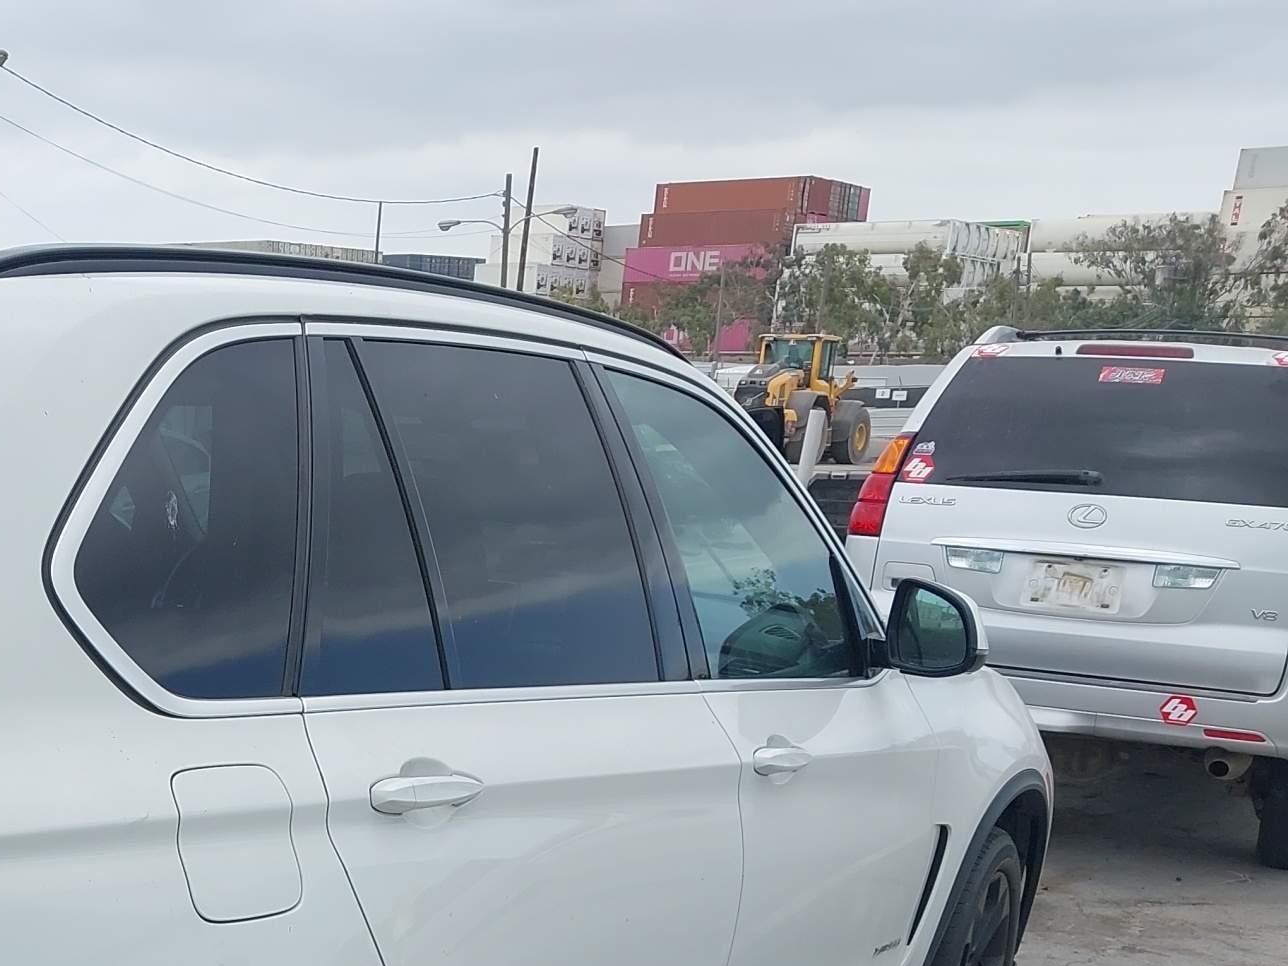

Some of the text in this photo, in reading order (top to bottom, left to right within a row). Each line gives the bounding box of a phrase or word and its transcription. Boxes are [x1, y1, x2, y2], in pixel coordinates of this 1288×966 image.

[669, 250, 721, 271] ONE
[899, 496, 956, 507] LEXUS
[1251, 608, 1278, 621] V8
